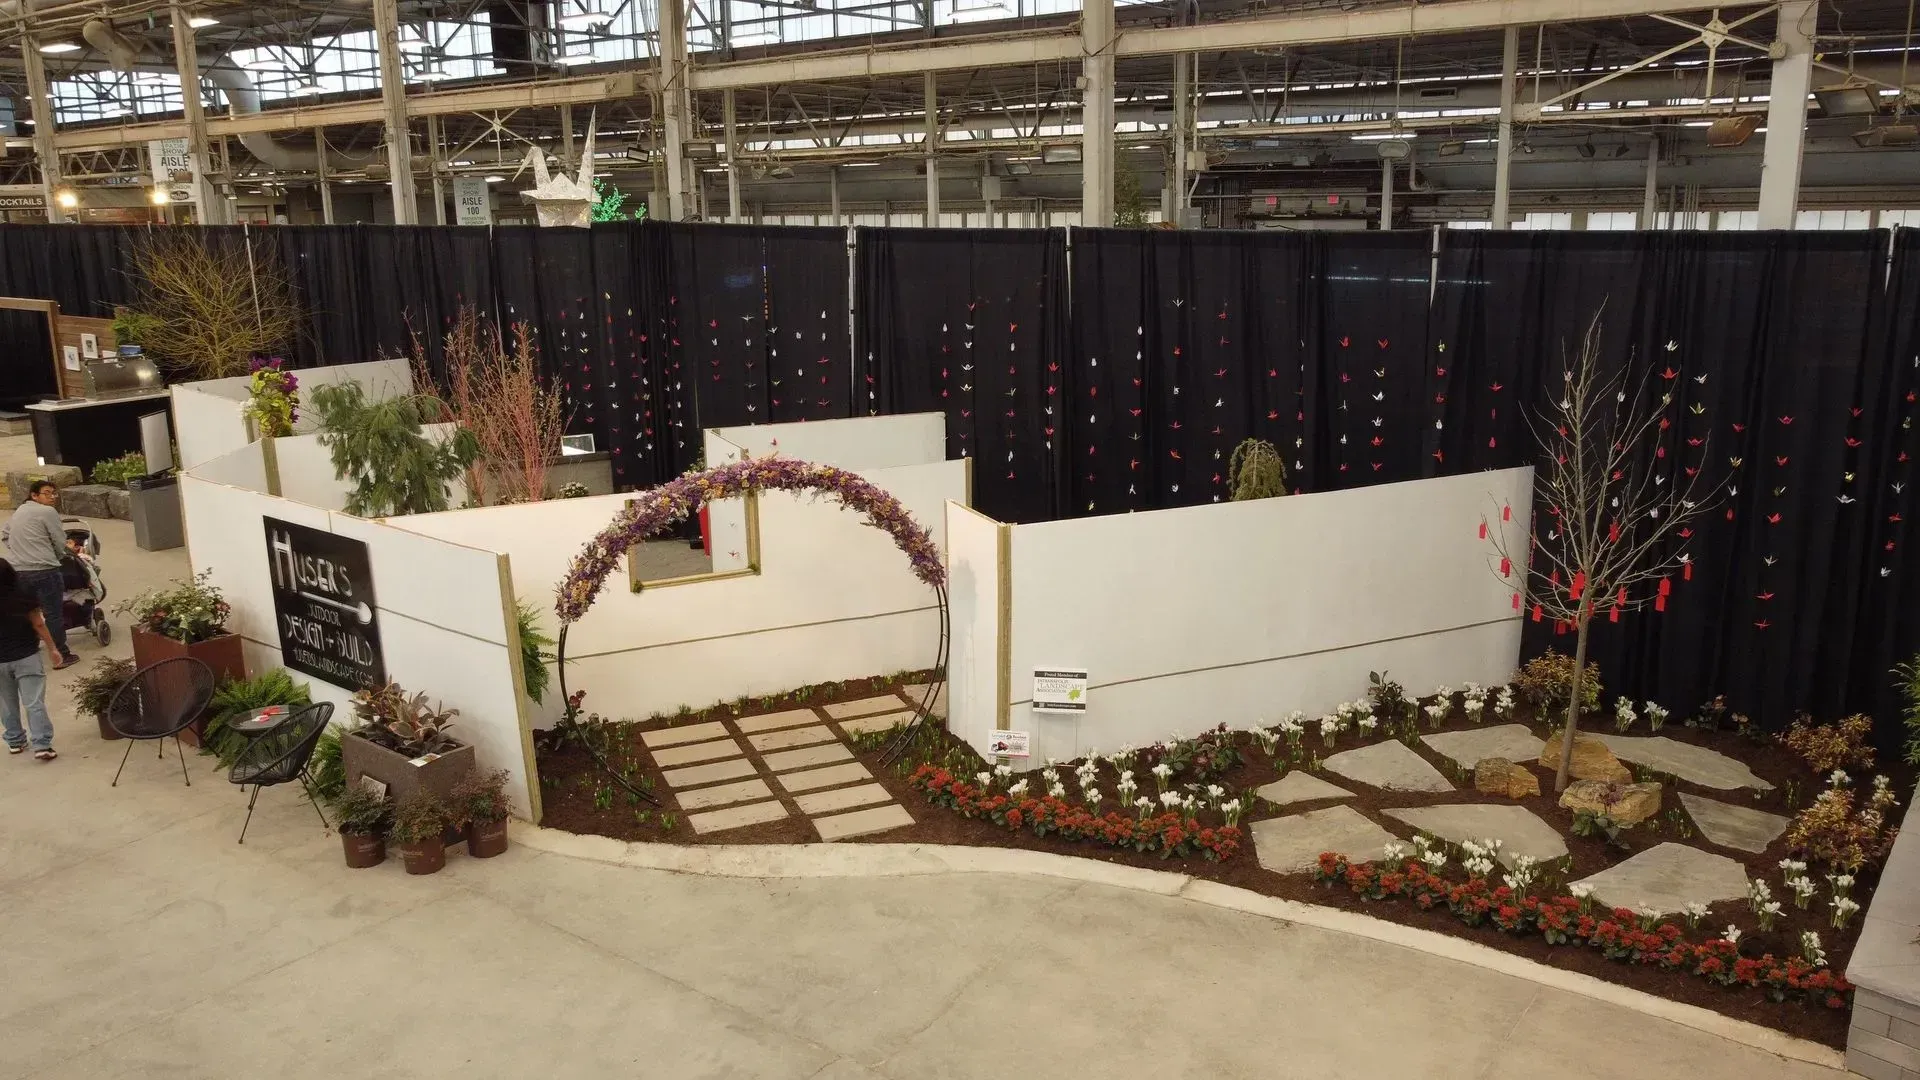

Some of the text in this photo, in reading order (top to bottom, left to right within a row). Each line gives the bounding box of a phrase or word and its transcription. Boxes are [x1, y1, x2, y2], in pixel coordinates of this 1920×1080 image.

[161, 156, 189, 167] AISLE
[0, 198, 43, 206] OCKTAILS
[462, 197, 483, 206] AISLE
[467, 206, 480, 215] 100
[271, 527, 353, 598] HUSER'S
[284, 613, 325, 651] DESIGN
[336, 629, 374, 666] BUILD
